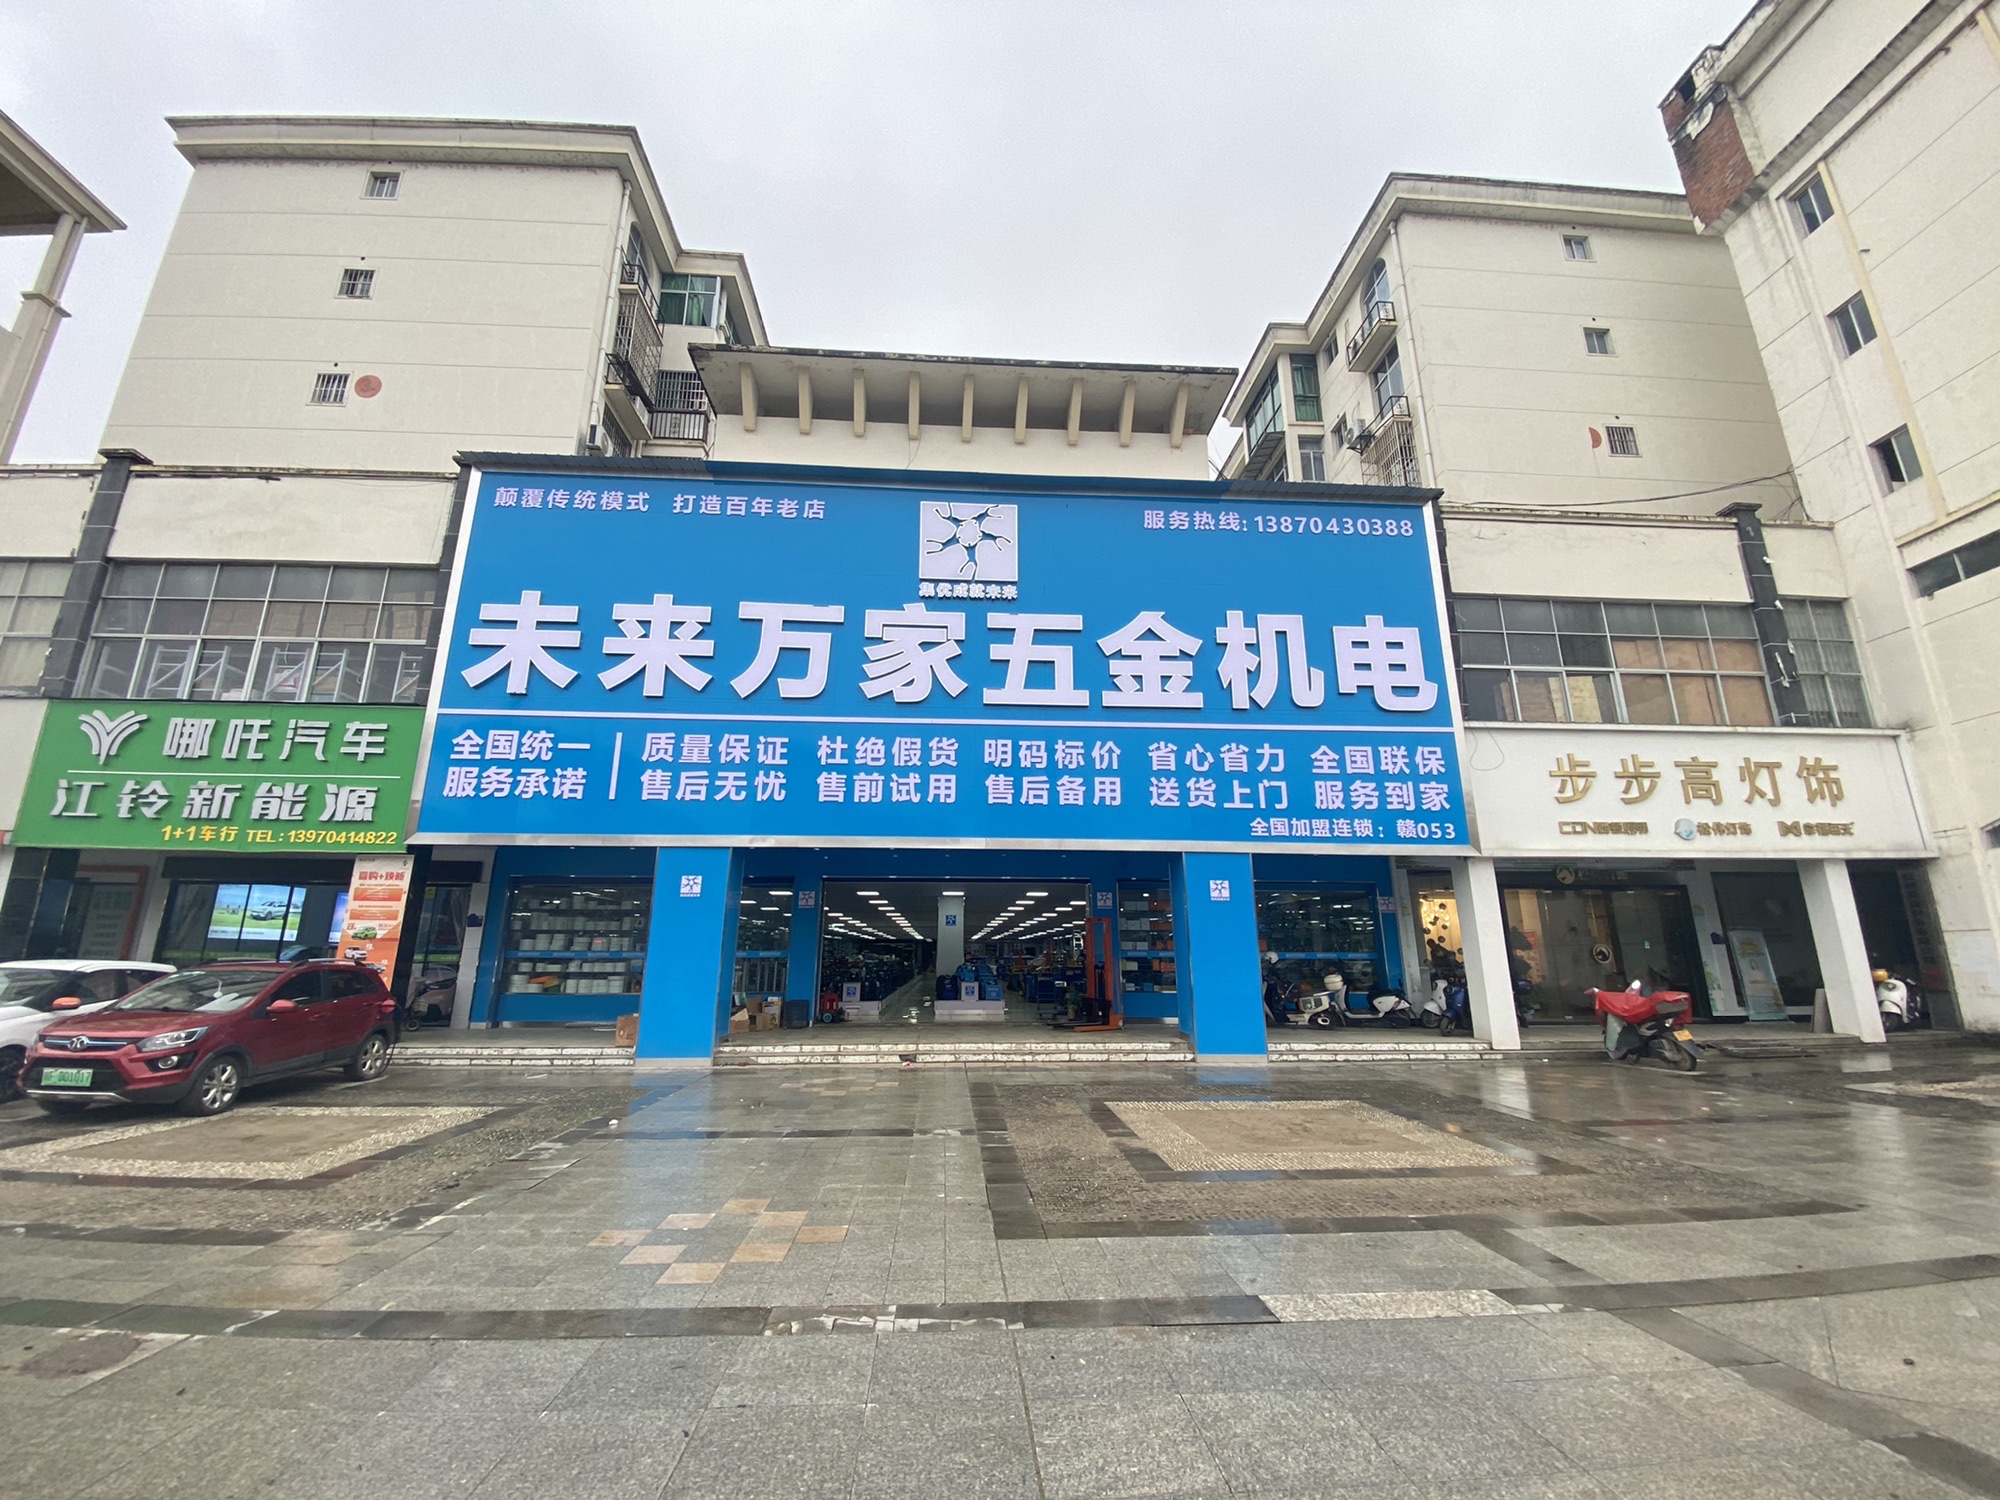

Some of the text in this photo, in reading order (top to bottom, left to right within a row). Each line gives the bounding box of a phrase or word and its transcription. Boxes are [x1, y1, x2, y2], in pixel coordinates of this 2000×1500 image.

[494, 486, 826, 520] 颠覆传统模式 打造百年老店
[460, 590, 1439, 712] 未来万家五金机电
[163, 717, 388, 762] 哪吒汽车
[450, 729, 591, 762] 全国统一
[641, 732, 1446, 777] 质量保证 杜绝假货 明码标价 省心省力 全国联保
[51, 779, 378, 823] 江铃新能源
[443, 766, 587, 801] 服务承诺
[640, 769, 1451, 812] 售后无忧 售前试用 售后备用 送货上门 服务到家
[1549, 753, 1845, 807] 步步高灯饰
[161, 825, 239, 843] 1+1车行
